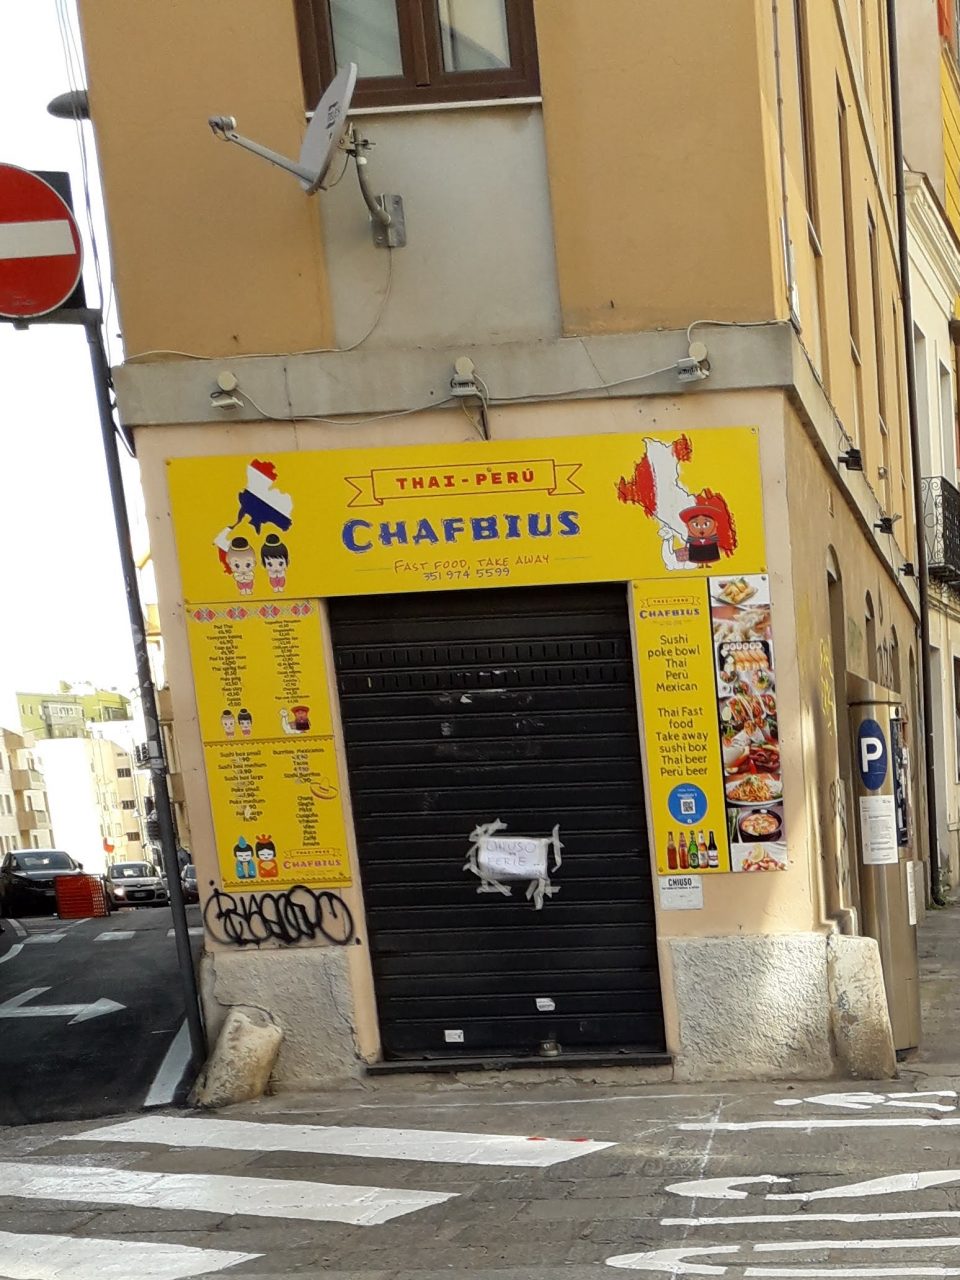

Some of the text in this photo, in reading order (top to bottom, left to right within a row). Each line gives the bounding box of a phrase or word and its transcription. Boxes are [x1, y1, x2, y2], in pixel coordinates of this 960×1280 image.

[341, 510, 582, 554] CHAFBIUS
[394, 559, 428, 574] FAST
[477, 557, 509, 567] TAKE
[515, 554, 549, 565] AWAY
[423, 567, 510, 581] 351 974 5599
[639, 608, 700, 619] CHAFBIUS
[660, 633, 688, 645] Sushi
[647, 644, 701, 660] poke bowl
[665, 658, 687, 668] Thai
[656, 682, 698, 692] Mexican
[658, 706, 703, 717] Thai Fast
[669, 718, 693, 729] food
[656, 731, 708, 742] Take away
[659, 743, 707, 753] sushi box
[661, 754, 707, 765] Thai beer
[861, 737, 883, 772] P
[686, 766, 708, 776] beer
[668, 877, 693, 887] CHIUSO
